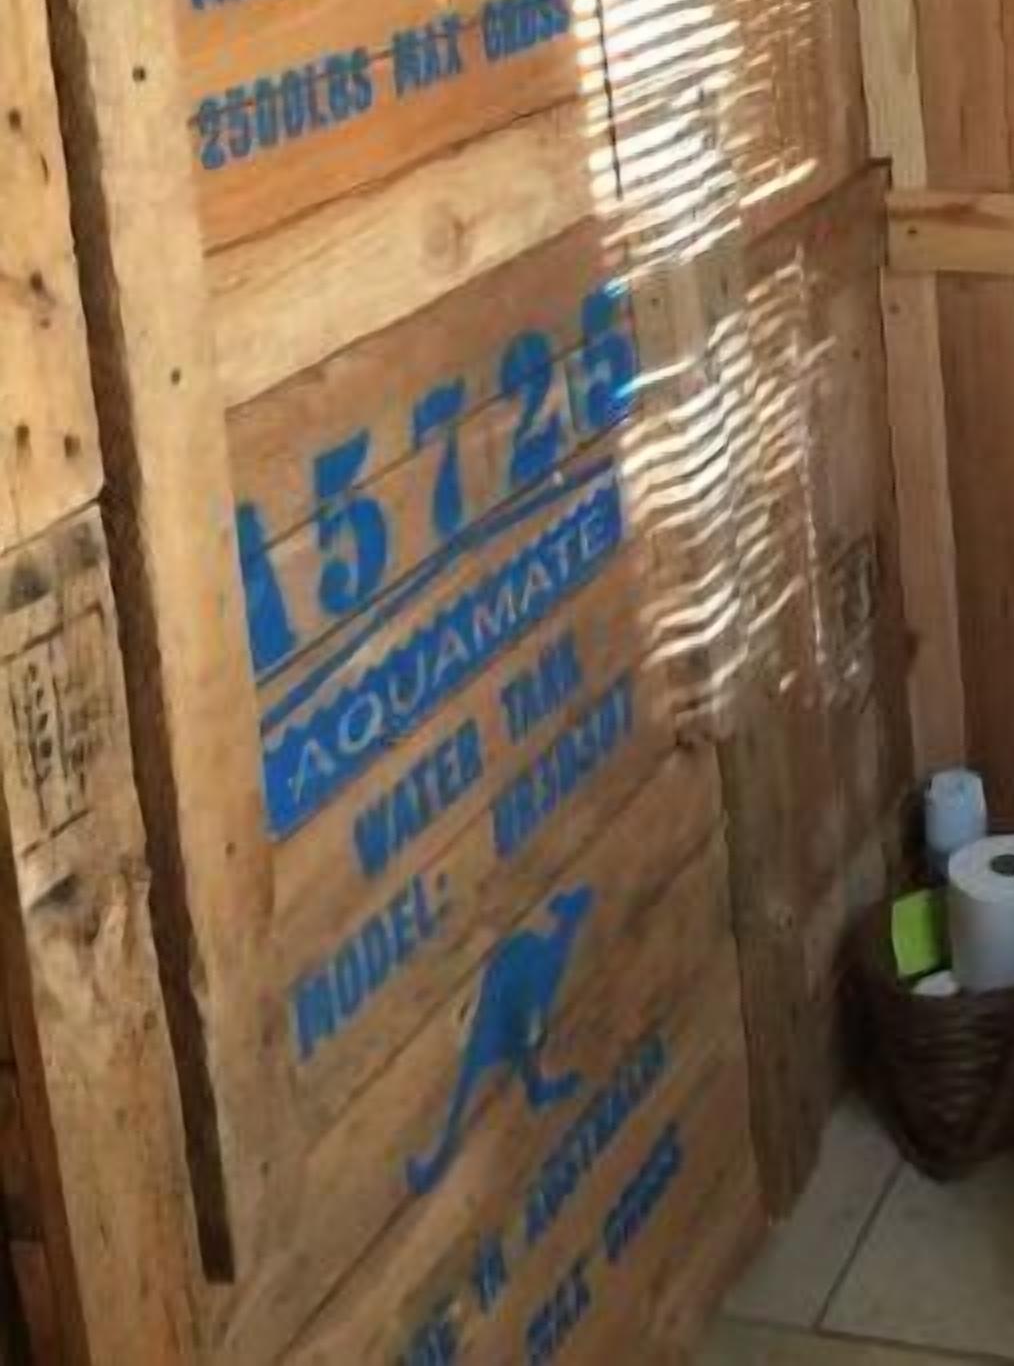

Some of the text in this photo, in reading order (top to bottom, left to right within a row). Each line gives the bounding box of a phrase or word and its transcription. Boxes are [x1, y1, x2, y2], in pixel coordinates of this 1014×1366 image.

[196, 46, 373, 170] 2500LBS
[392, 12, 462, 98] MAX
[286, 498, 616, 802] AQUAMATE
[354, 714, 485, 879] WATER
